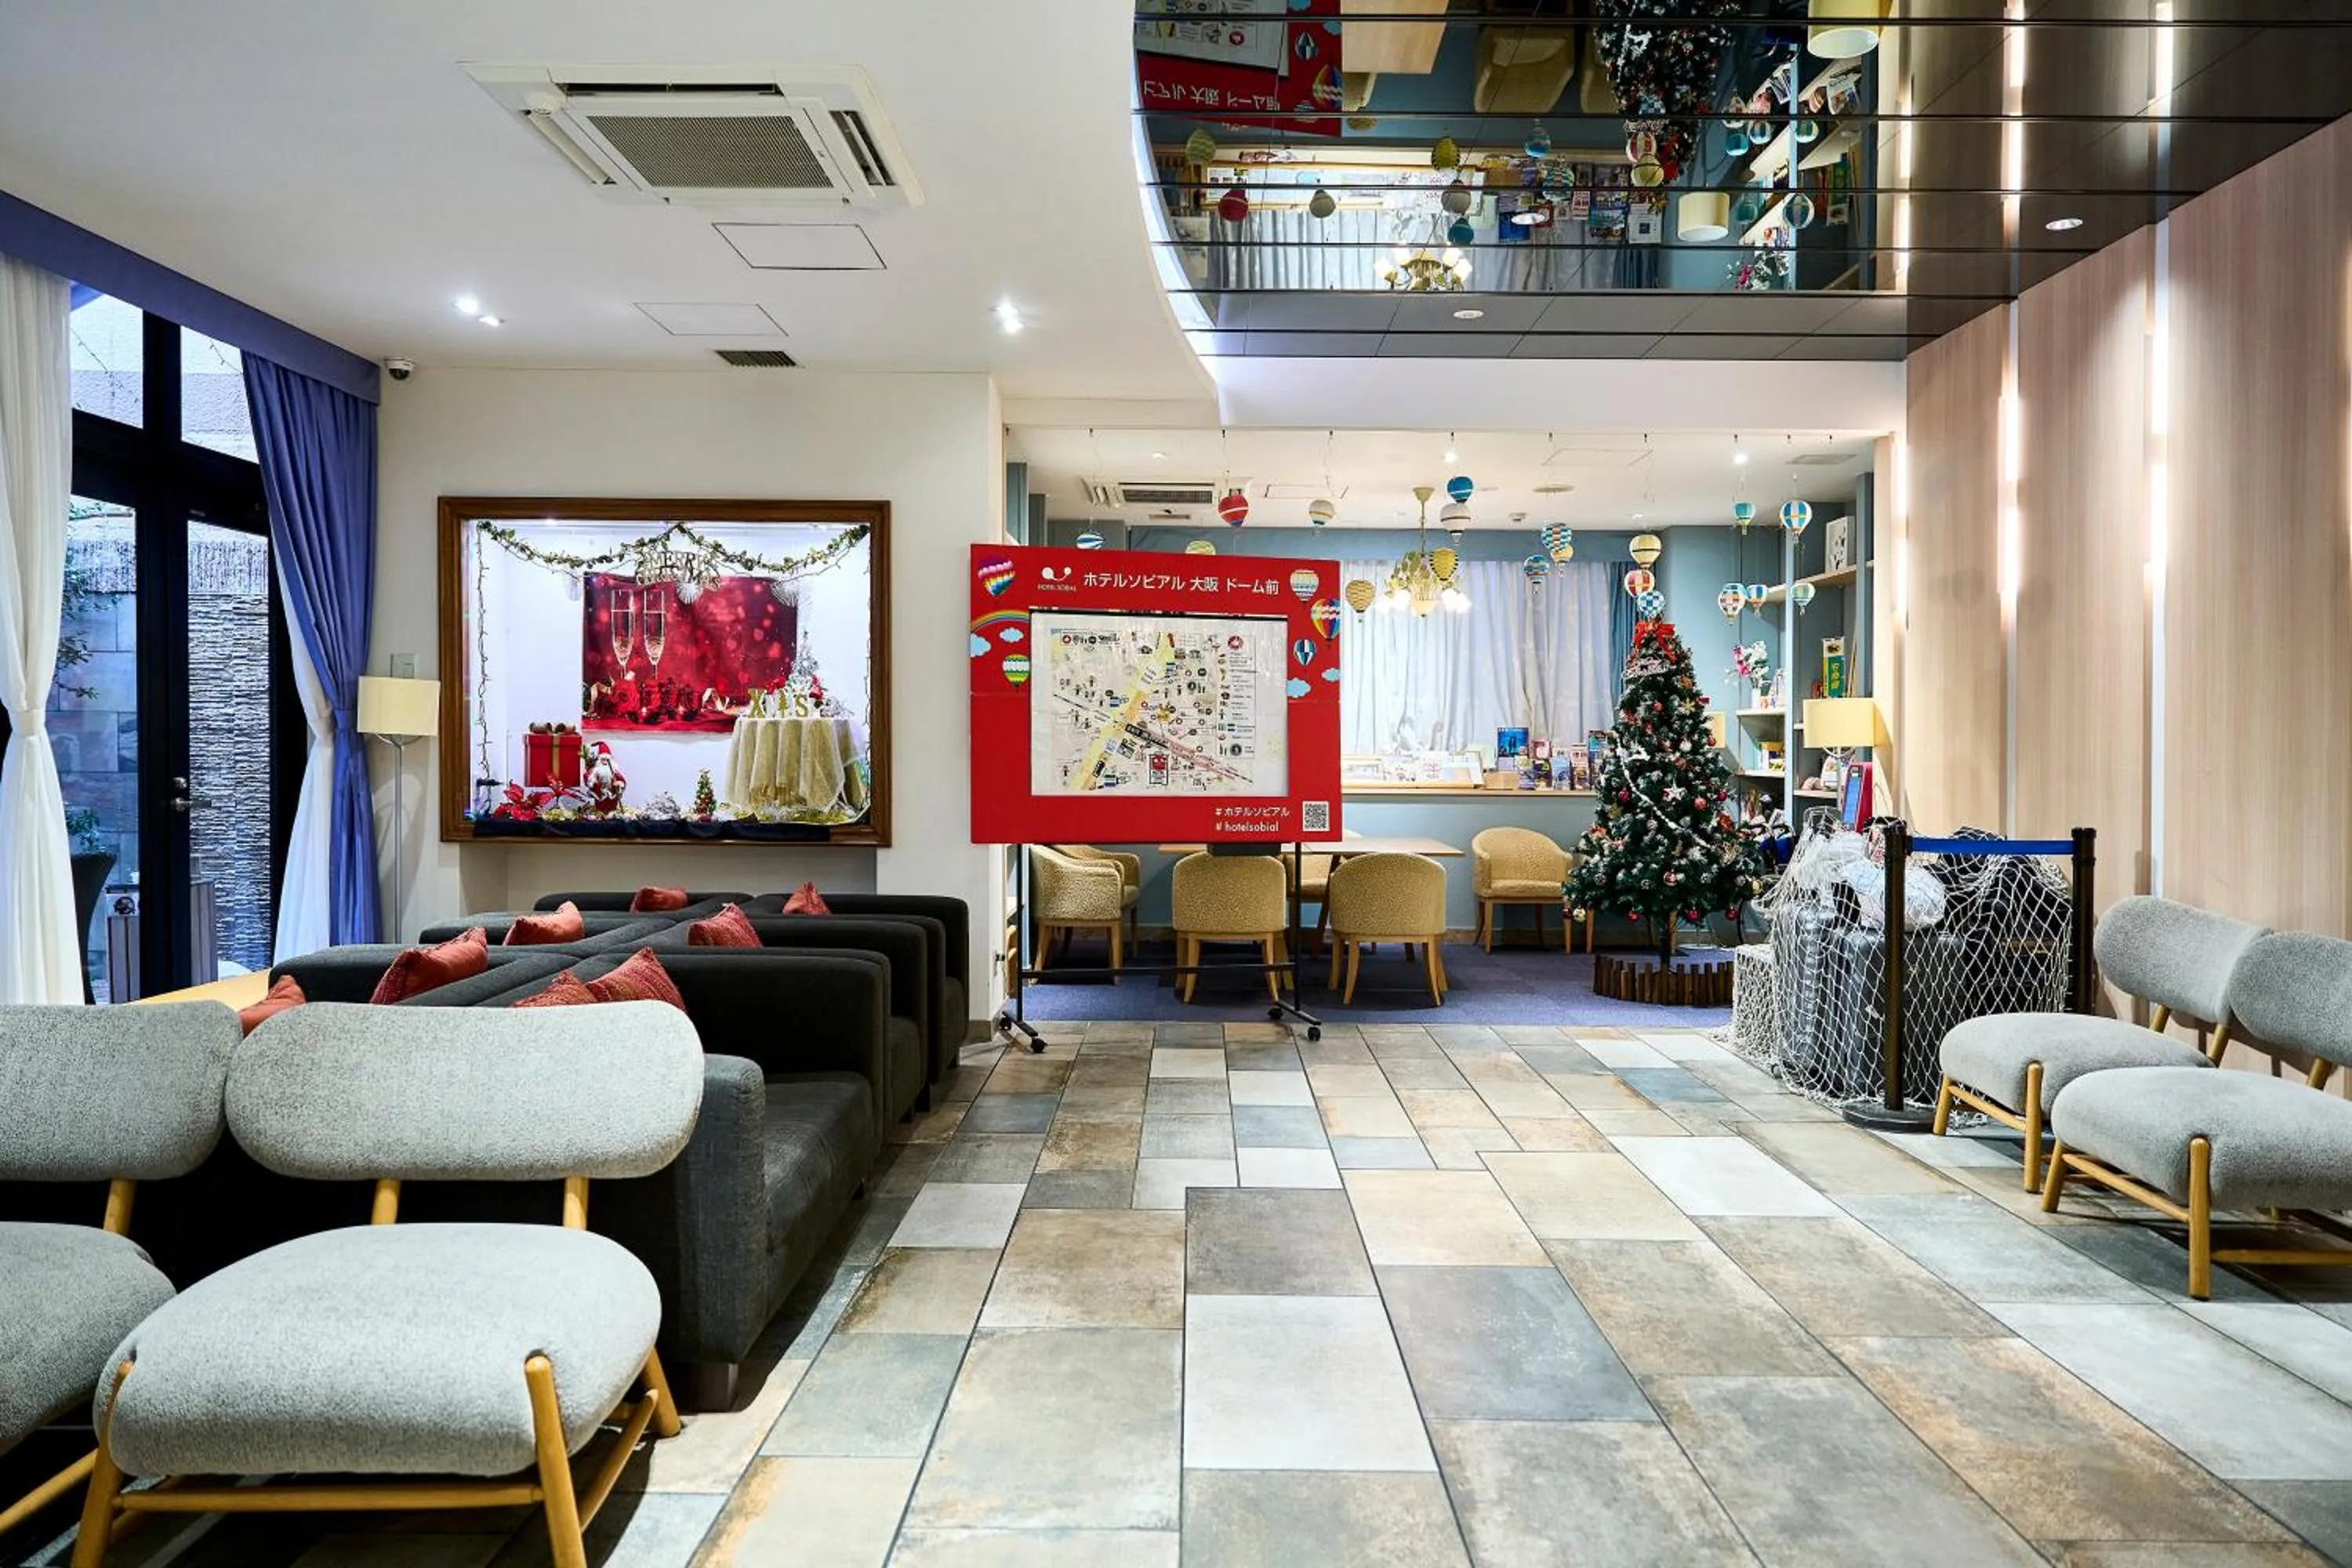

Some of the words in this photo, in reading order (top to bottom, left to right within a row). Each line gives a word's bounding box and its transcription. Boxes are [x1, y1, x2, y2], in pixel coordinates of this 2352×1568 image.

[1083, 572, 1186, 590] ホテルソビアル
[1190, 577, 1219, 592] 大阪
[1226, 578, 1279, 595] ドーム前
[1225, 807, 1290, 816] ホテルソビアル
[1225, 821, 1279, 832] hotelsobial
